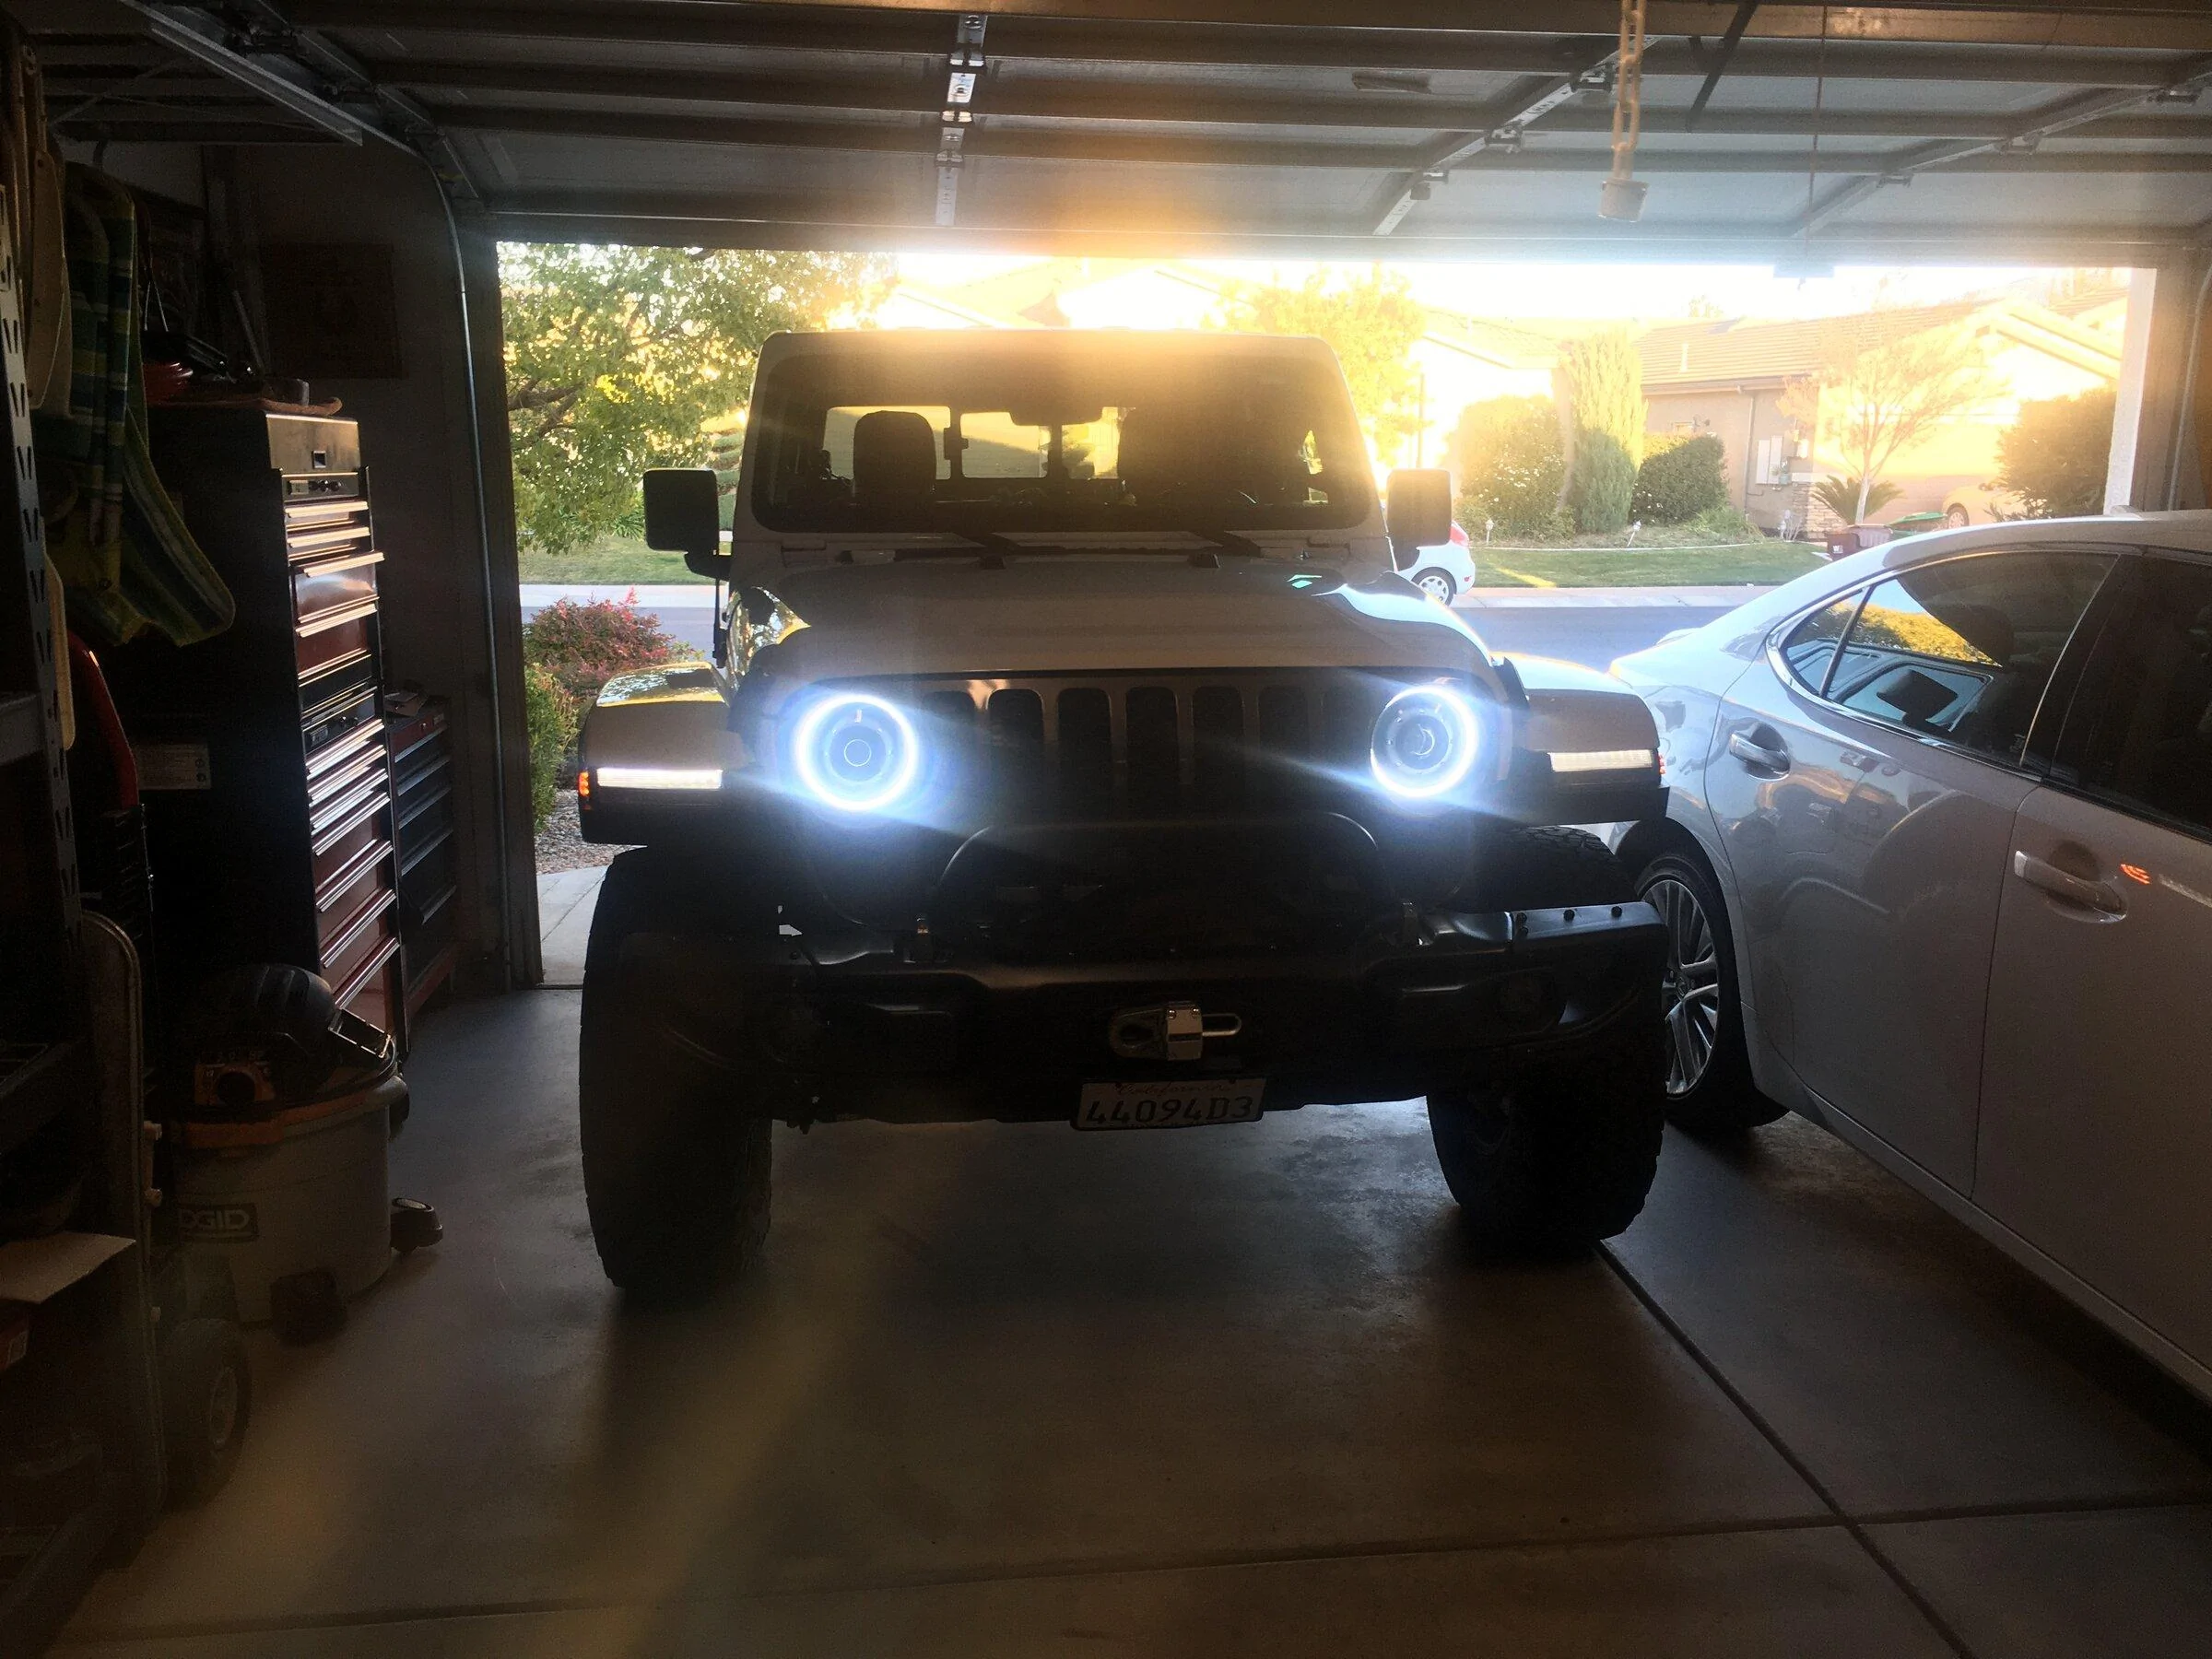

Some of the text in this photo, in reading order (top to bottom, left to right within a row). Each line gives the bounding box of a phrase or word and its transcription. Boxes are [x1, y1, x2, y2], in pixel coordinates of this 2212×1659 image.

[1118, 1080, 1231, 1097] California
[1086, 1096, 1253, 1124] 44094D3
[176, 1208, 251, 1230] DGID
